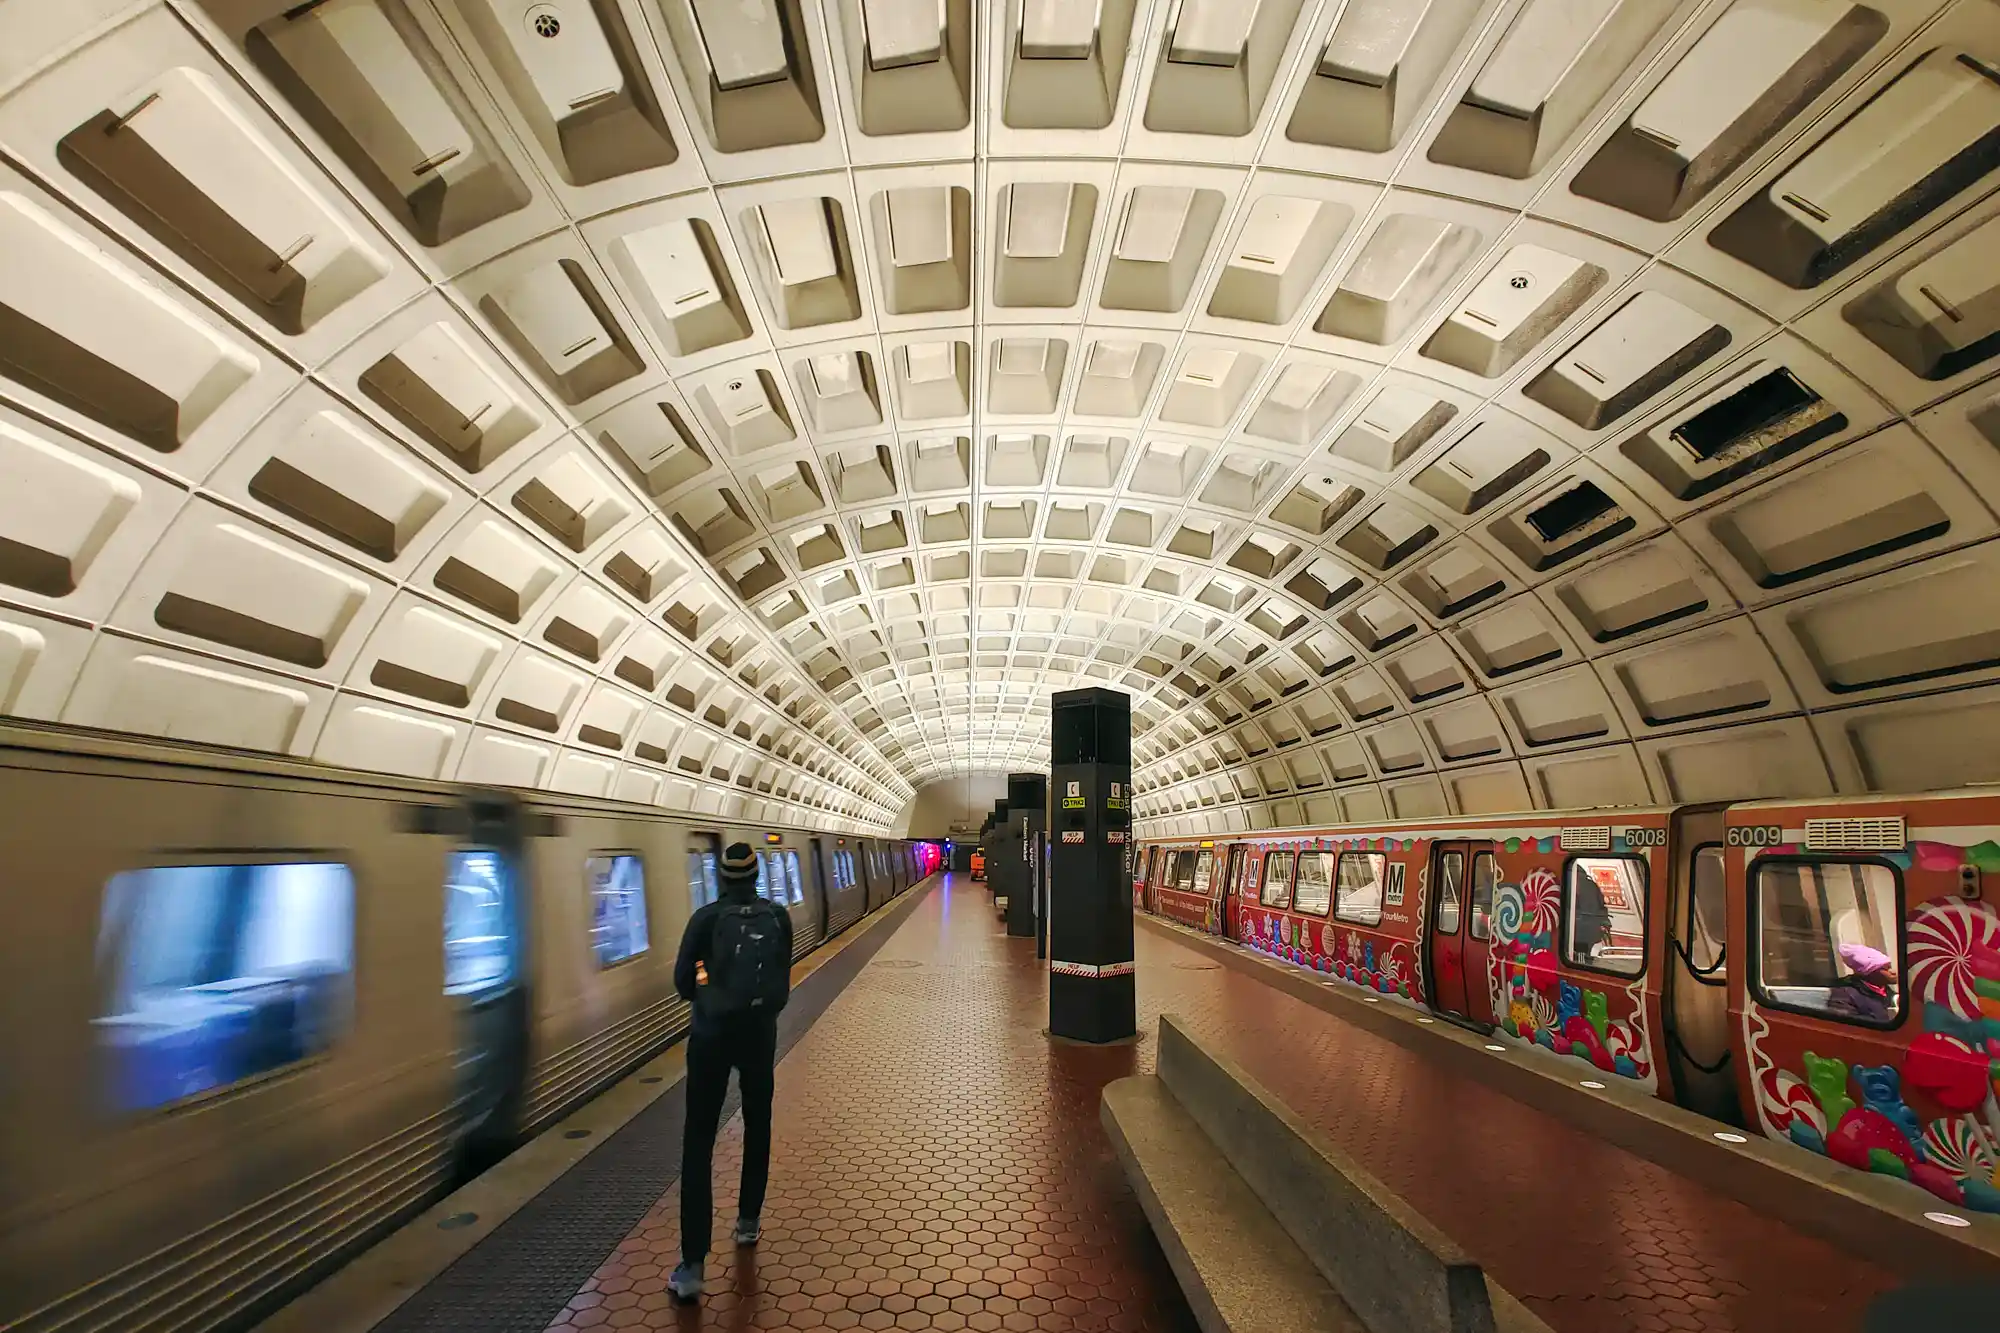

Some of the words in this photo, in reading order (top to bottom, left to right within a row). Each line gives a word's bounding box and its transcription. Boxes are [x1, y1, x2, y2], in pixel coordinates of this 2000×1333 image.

[1625, 829, 1666, 846] 6008
[1727, 826, 1781, 846] 6009
[1388, 865, 1404, 894] M
